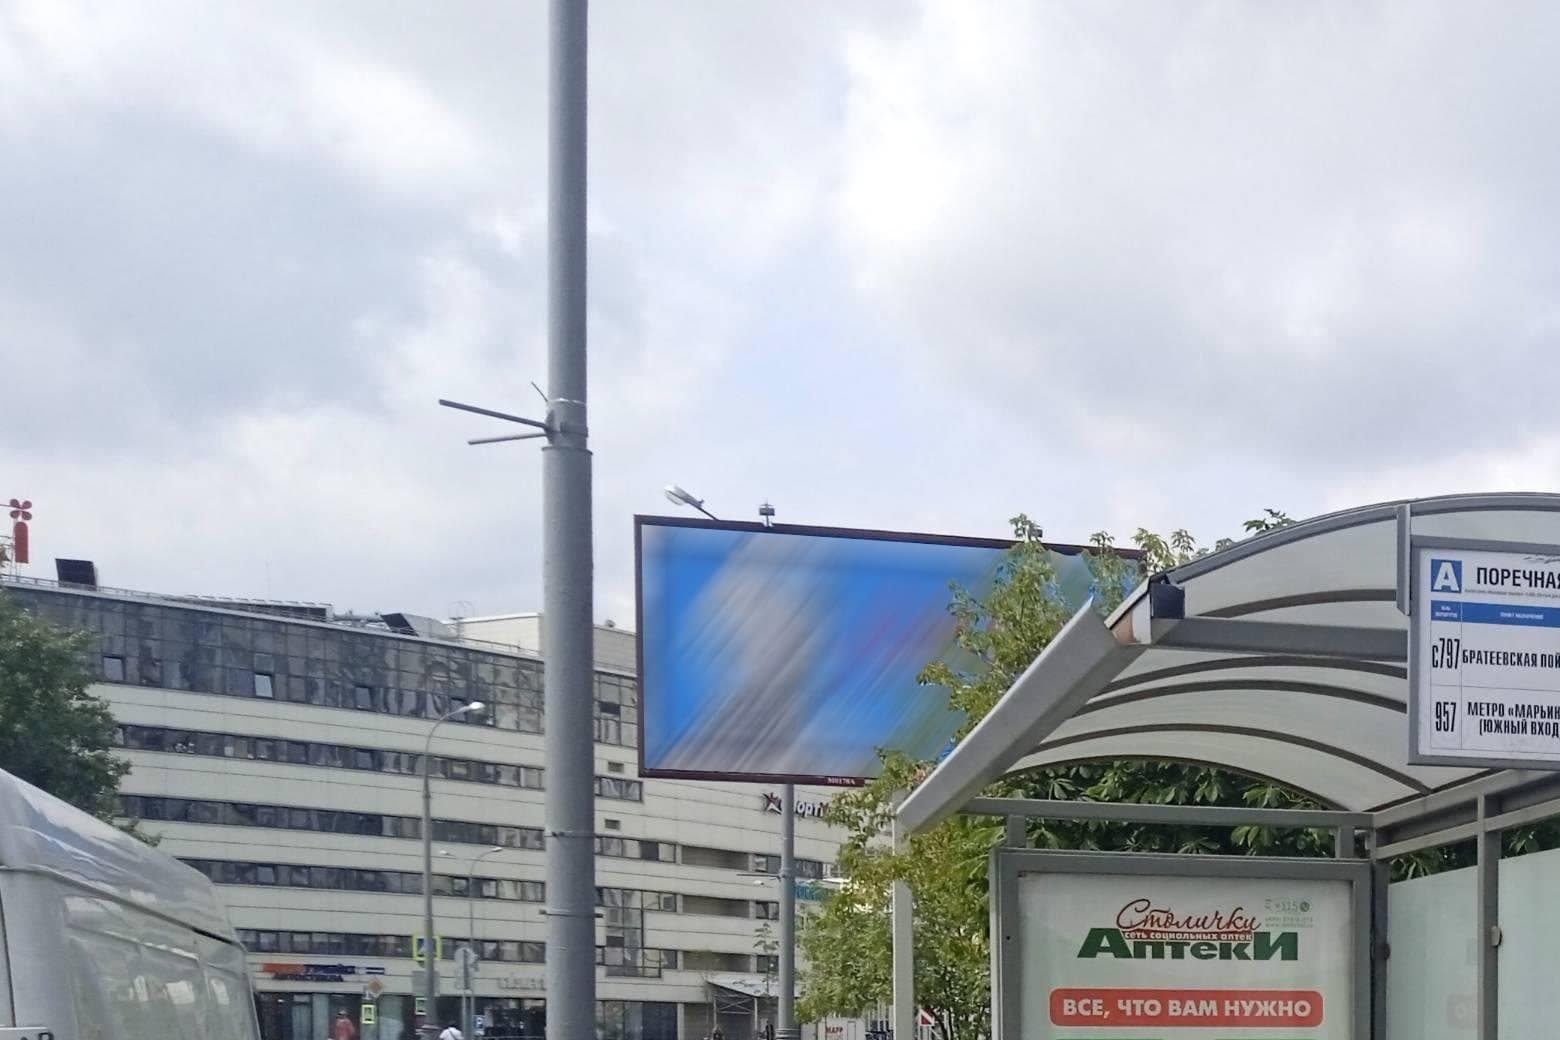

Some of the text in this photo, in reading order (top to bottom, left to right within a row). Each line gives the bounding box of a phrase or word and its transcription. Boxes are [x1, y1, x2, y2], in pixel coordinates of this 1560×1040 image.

[1462, 649, 1538, 668] БРАТЕЕВСКАЯ
[1435, 701, 1457, 732] 957
[1468, 701, 1505, 718] МЕТРО
[1479, 718, 1528, 736] (ЮЖНЫЙ
[1116, 898, 1262, 932] Столички
[1125, 932, 1253, 941] сеть социальных аптек
[1063, 998, 1312, 1019] ВСЕ, ЧТО ВАМ НУЖНО
